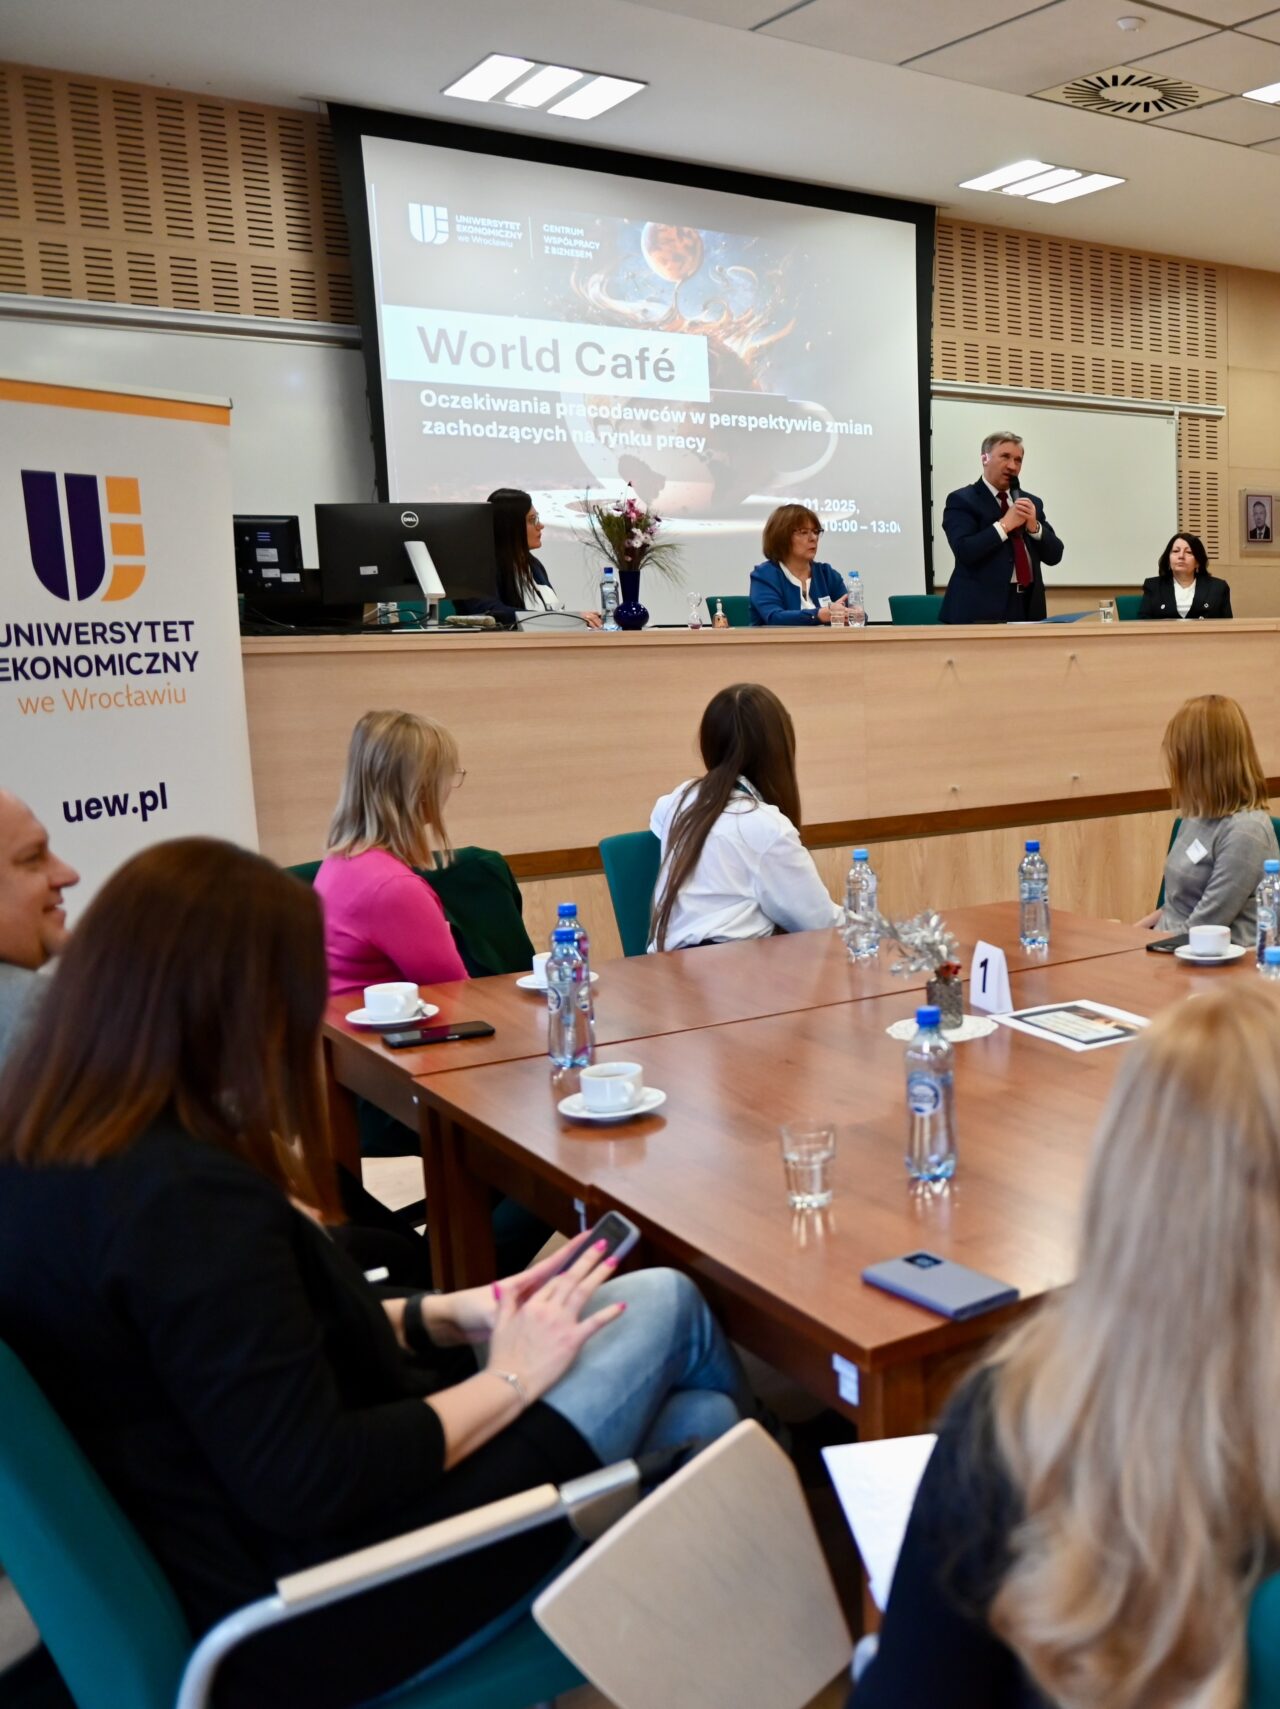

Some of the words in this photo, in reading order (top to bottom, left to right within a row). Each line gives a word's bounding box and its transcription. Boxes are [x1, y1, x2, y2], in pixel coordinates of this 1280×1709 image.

[455, 215, 521, 230] UNIWERSYTET
[456, 225, 523, 240] EKONOMICZNY
[543, 223, 584, 237] CENTRUM
[551, 247, 593, 259] BIZNESEM
[416, 325, 561, 374] World
[575, 341, 676, 383] Café
[420, 389, 551, 415] Oczekiwania
[555, 398, 686, 424] pracodawców
[690, 411, 706, 425] w
[709, 413, 822, 434] perspektywie
[825, 419, 873, 436] zmian
[422, 419, 567, 446] zachodzących
[573, 429, 595, 443] na
[599, 428, 652, 452] rynku
[656, 434, 706, 453] pracy
[823, 520, 858, 532] 10:00
[18, 691, 55, 715] we
[62, 682, 187, 713] Wrocławiu
[62, 782, 168, 823] uew.pl
[979, 957, 988, 993] 1
